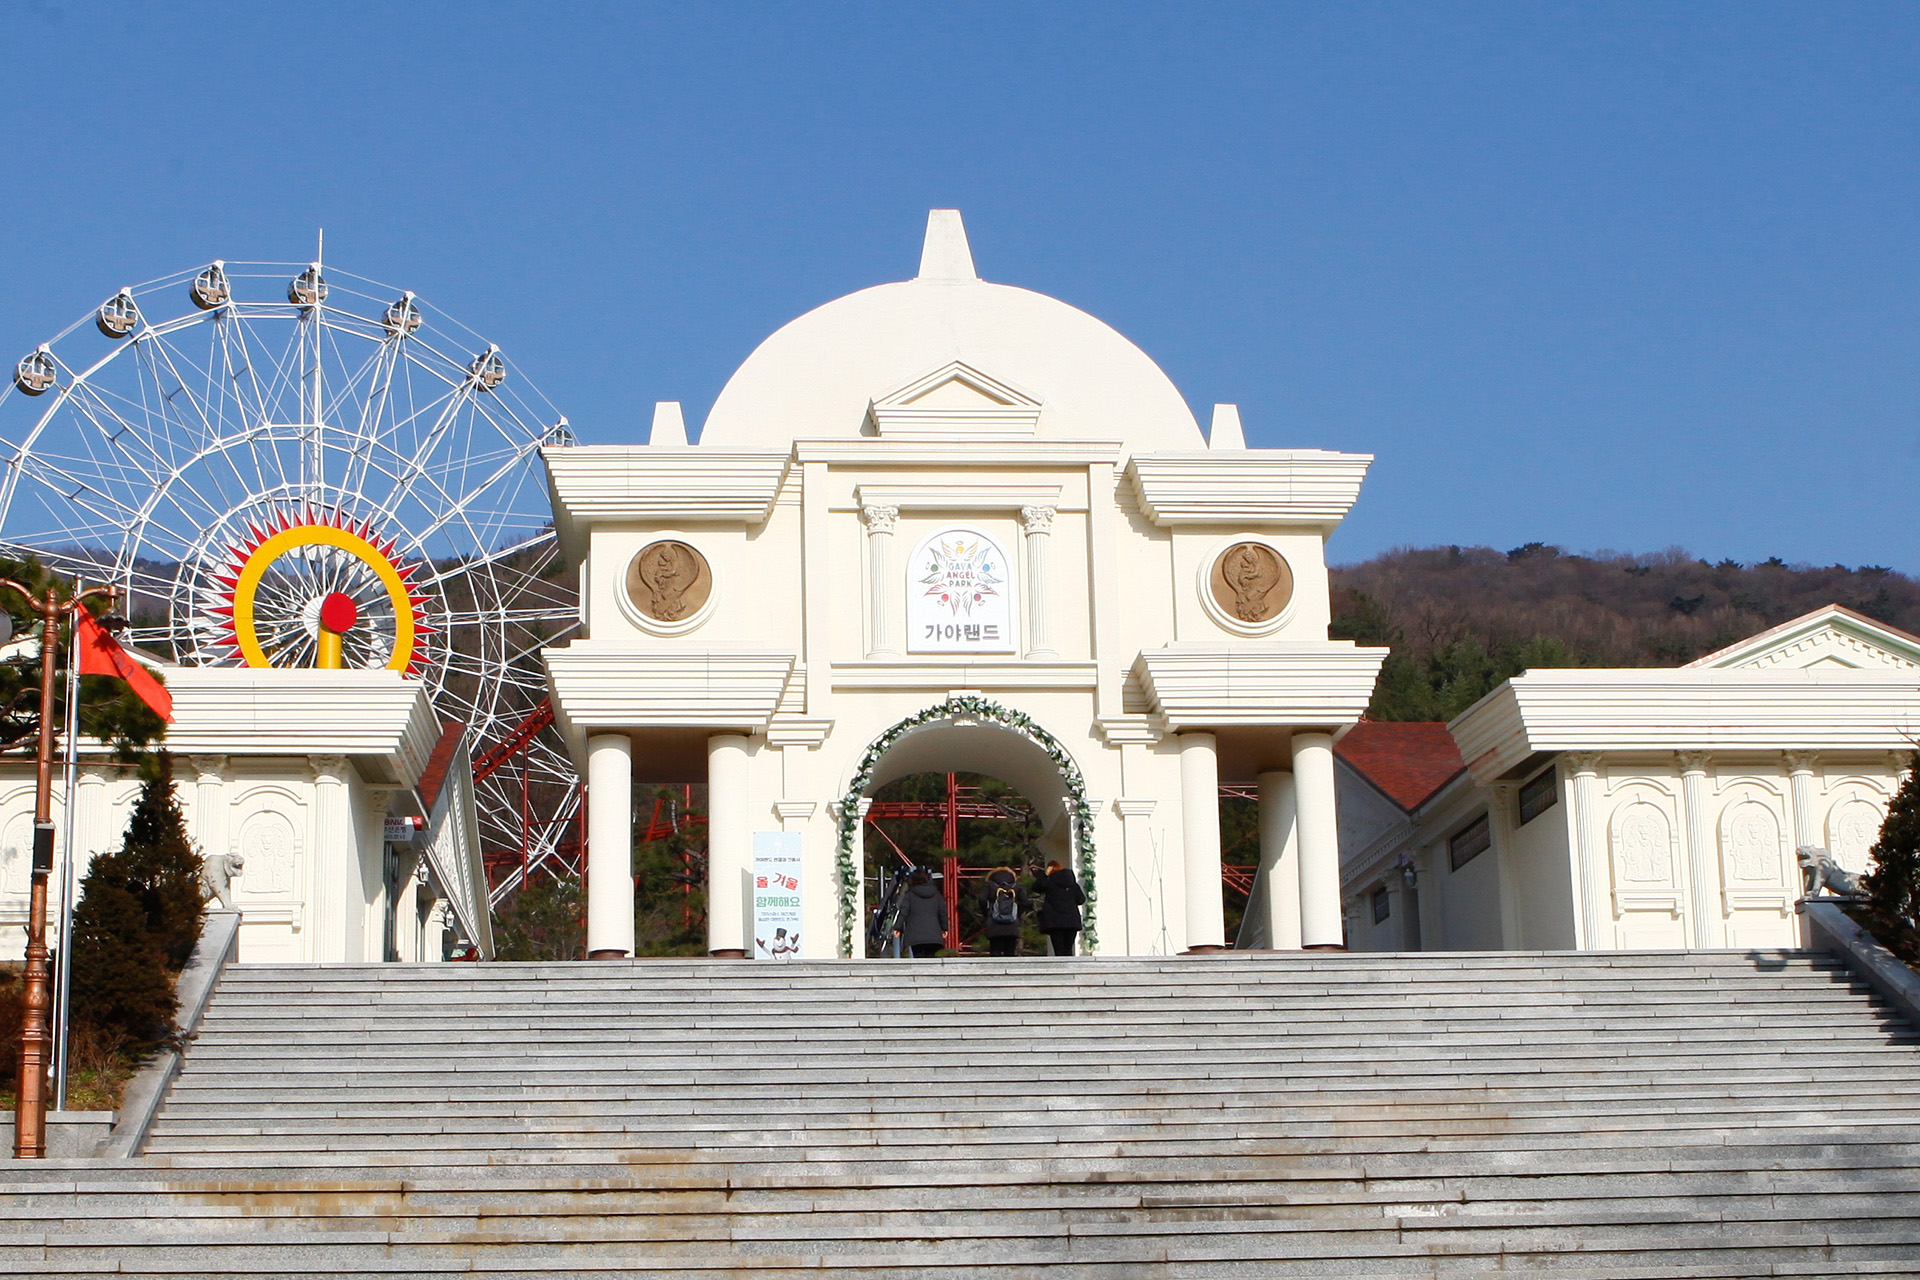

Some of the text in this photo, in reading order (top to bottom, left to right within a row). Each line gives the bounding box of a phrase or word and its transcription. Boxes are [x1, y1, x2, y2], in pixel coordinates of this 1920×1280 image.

[948, 562, 972, 571] GAYA
[946, 571, 976, 579] ANGEL
[949, 579, 972, 588] PARK
[925, 624, 999, 641] 가야랜드
[756, 872, 798, 890] 올 겨울
[756, 896, 800, 907] 함께해요
